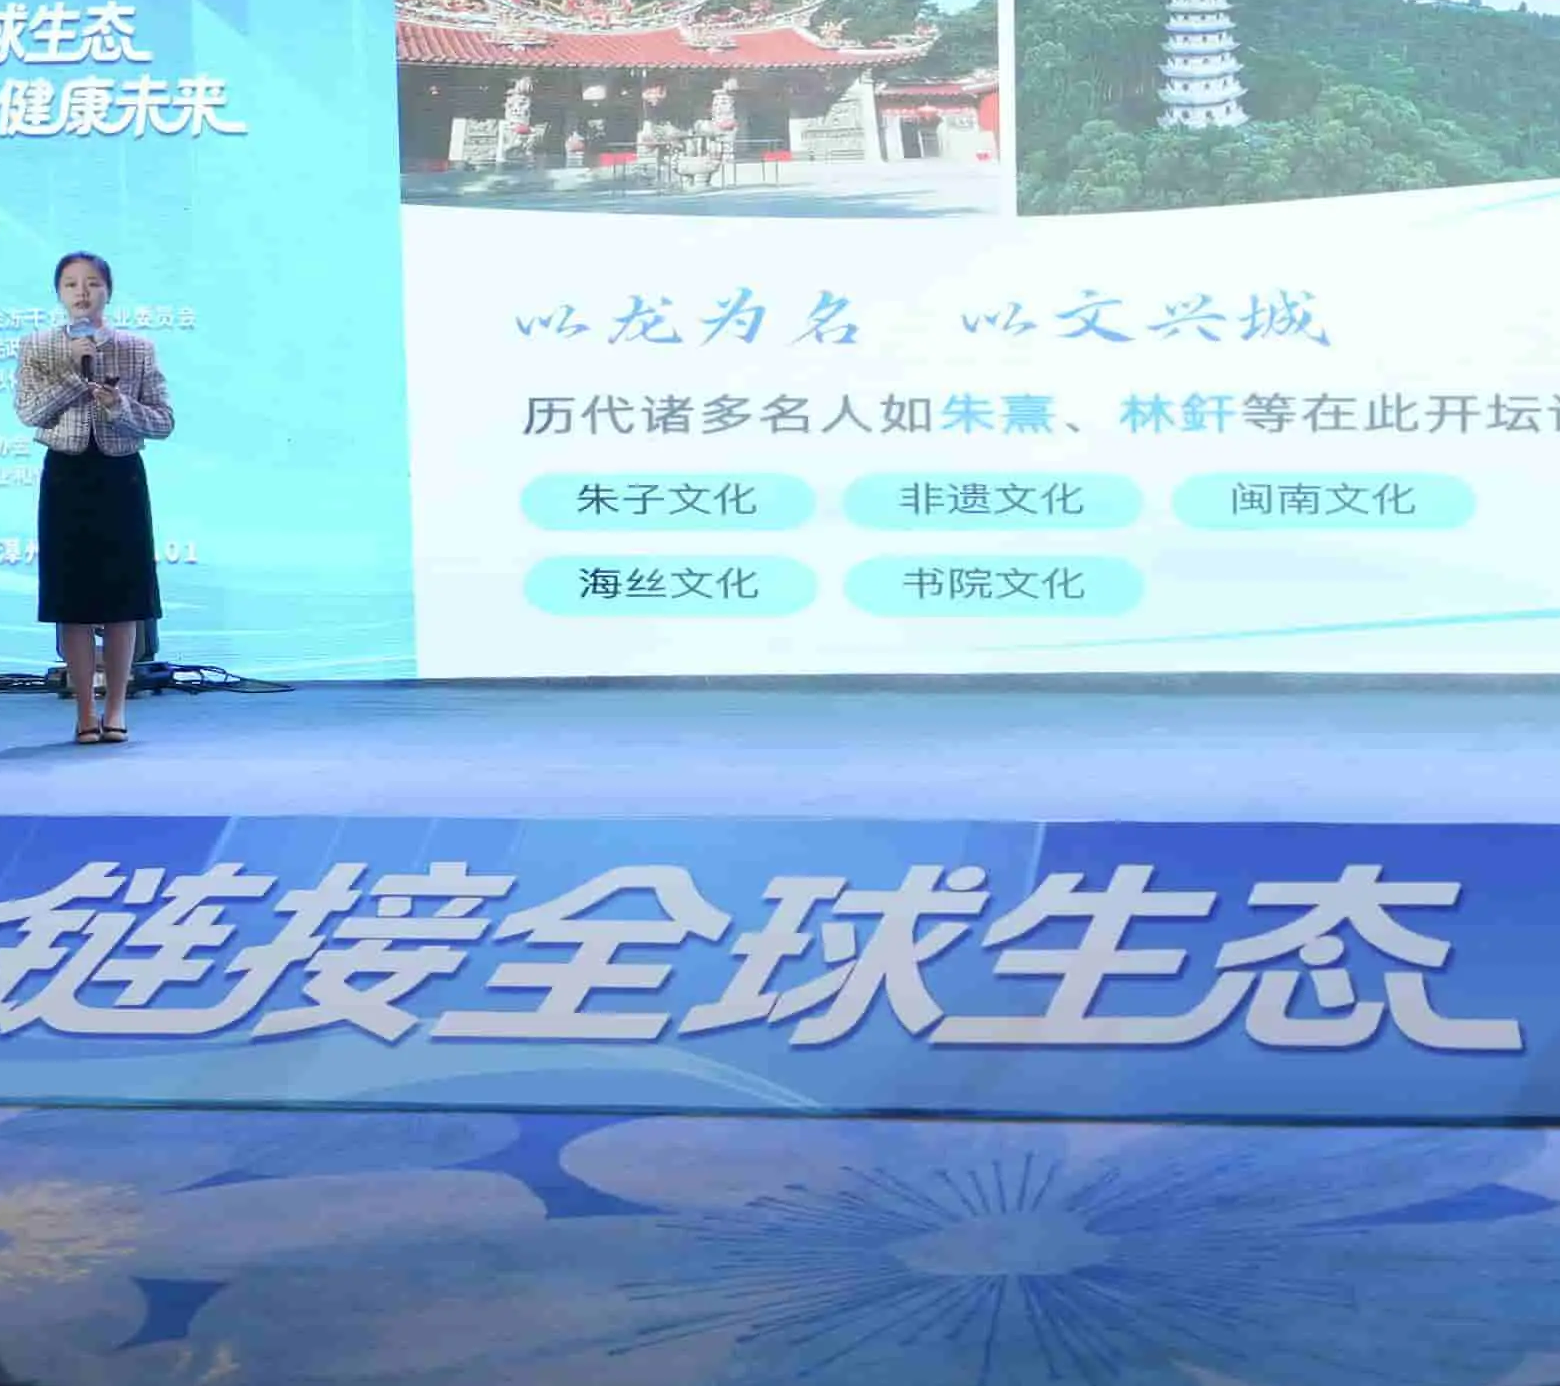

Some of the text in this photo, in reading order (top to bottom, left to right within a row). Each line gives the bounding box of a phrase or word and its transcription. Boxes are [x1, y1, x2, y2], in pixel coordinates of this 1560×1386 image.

[515, 287, 1333, 348] 以龙为名 以文兴城
[576, 481, 1417, 516] 朱子文化 非遗文化 闽南文化
[579, 566, 1086, 600] 海丝文化 书院文化
